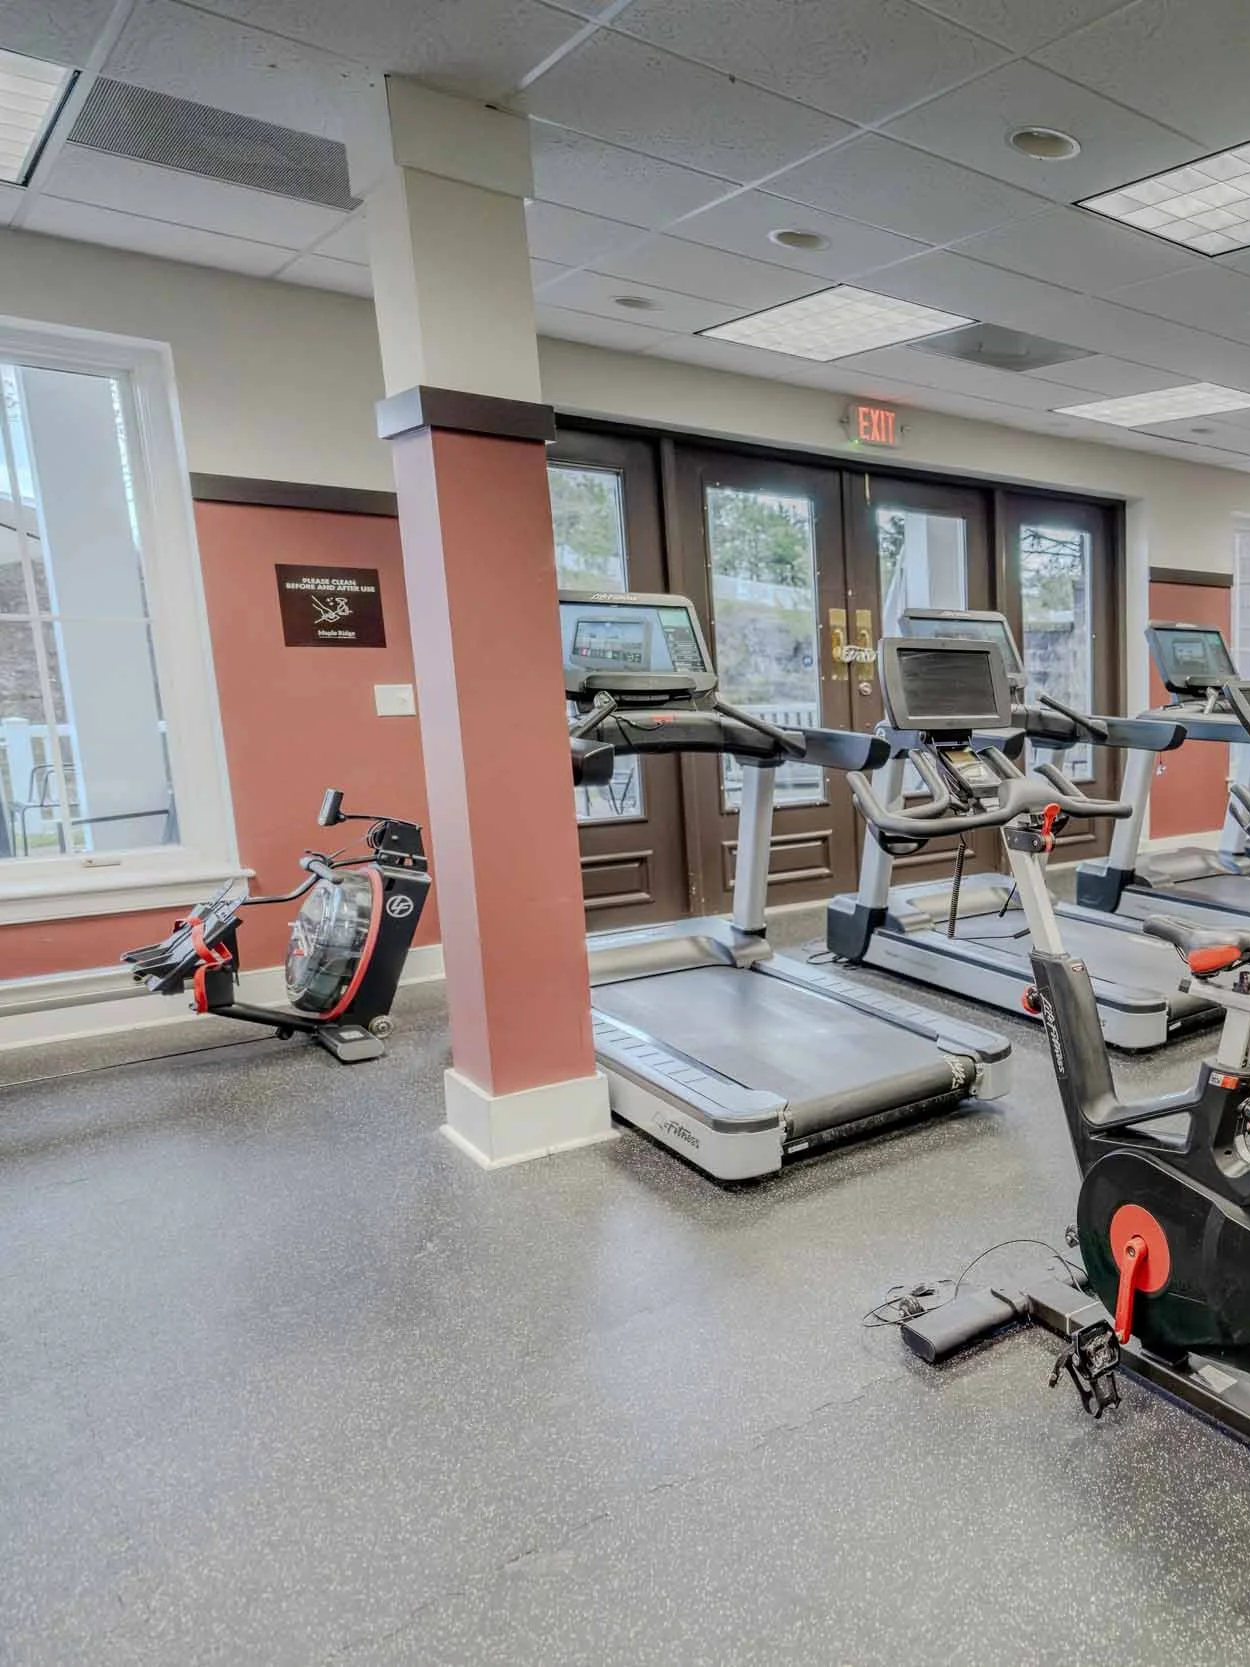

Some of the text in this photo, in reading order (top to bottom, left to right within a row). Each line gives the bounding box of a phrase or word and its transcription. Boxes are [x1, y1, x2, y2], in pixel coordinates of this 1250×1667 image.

[858, 406, 895, 444] EXIT
[302, 577, 330, 585] PLEASE
[285, 582, 375, 593] BEFORE AND AFTER USE
